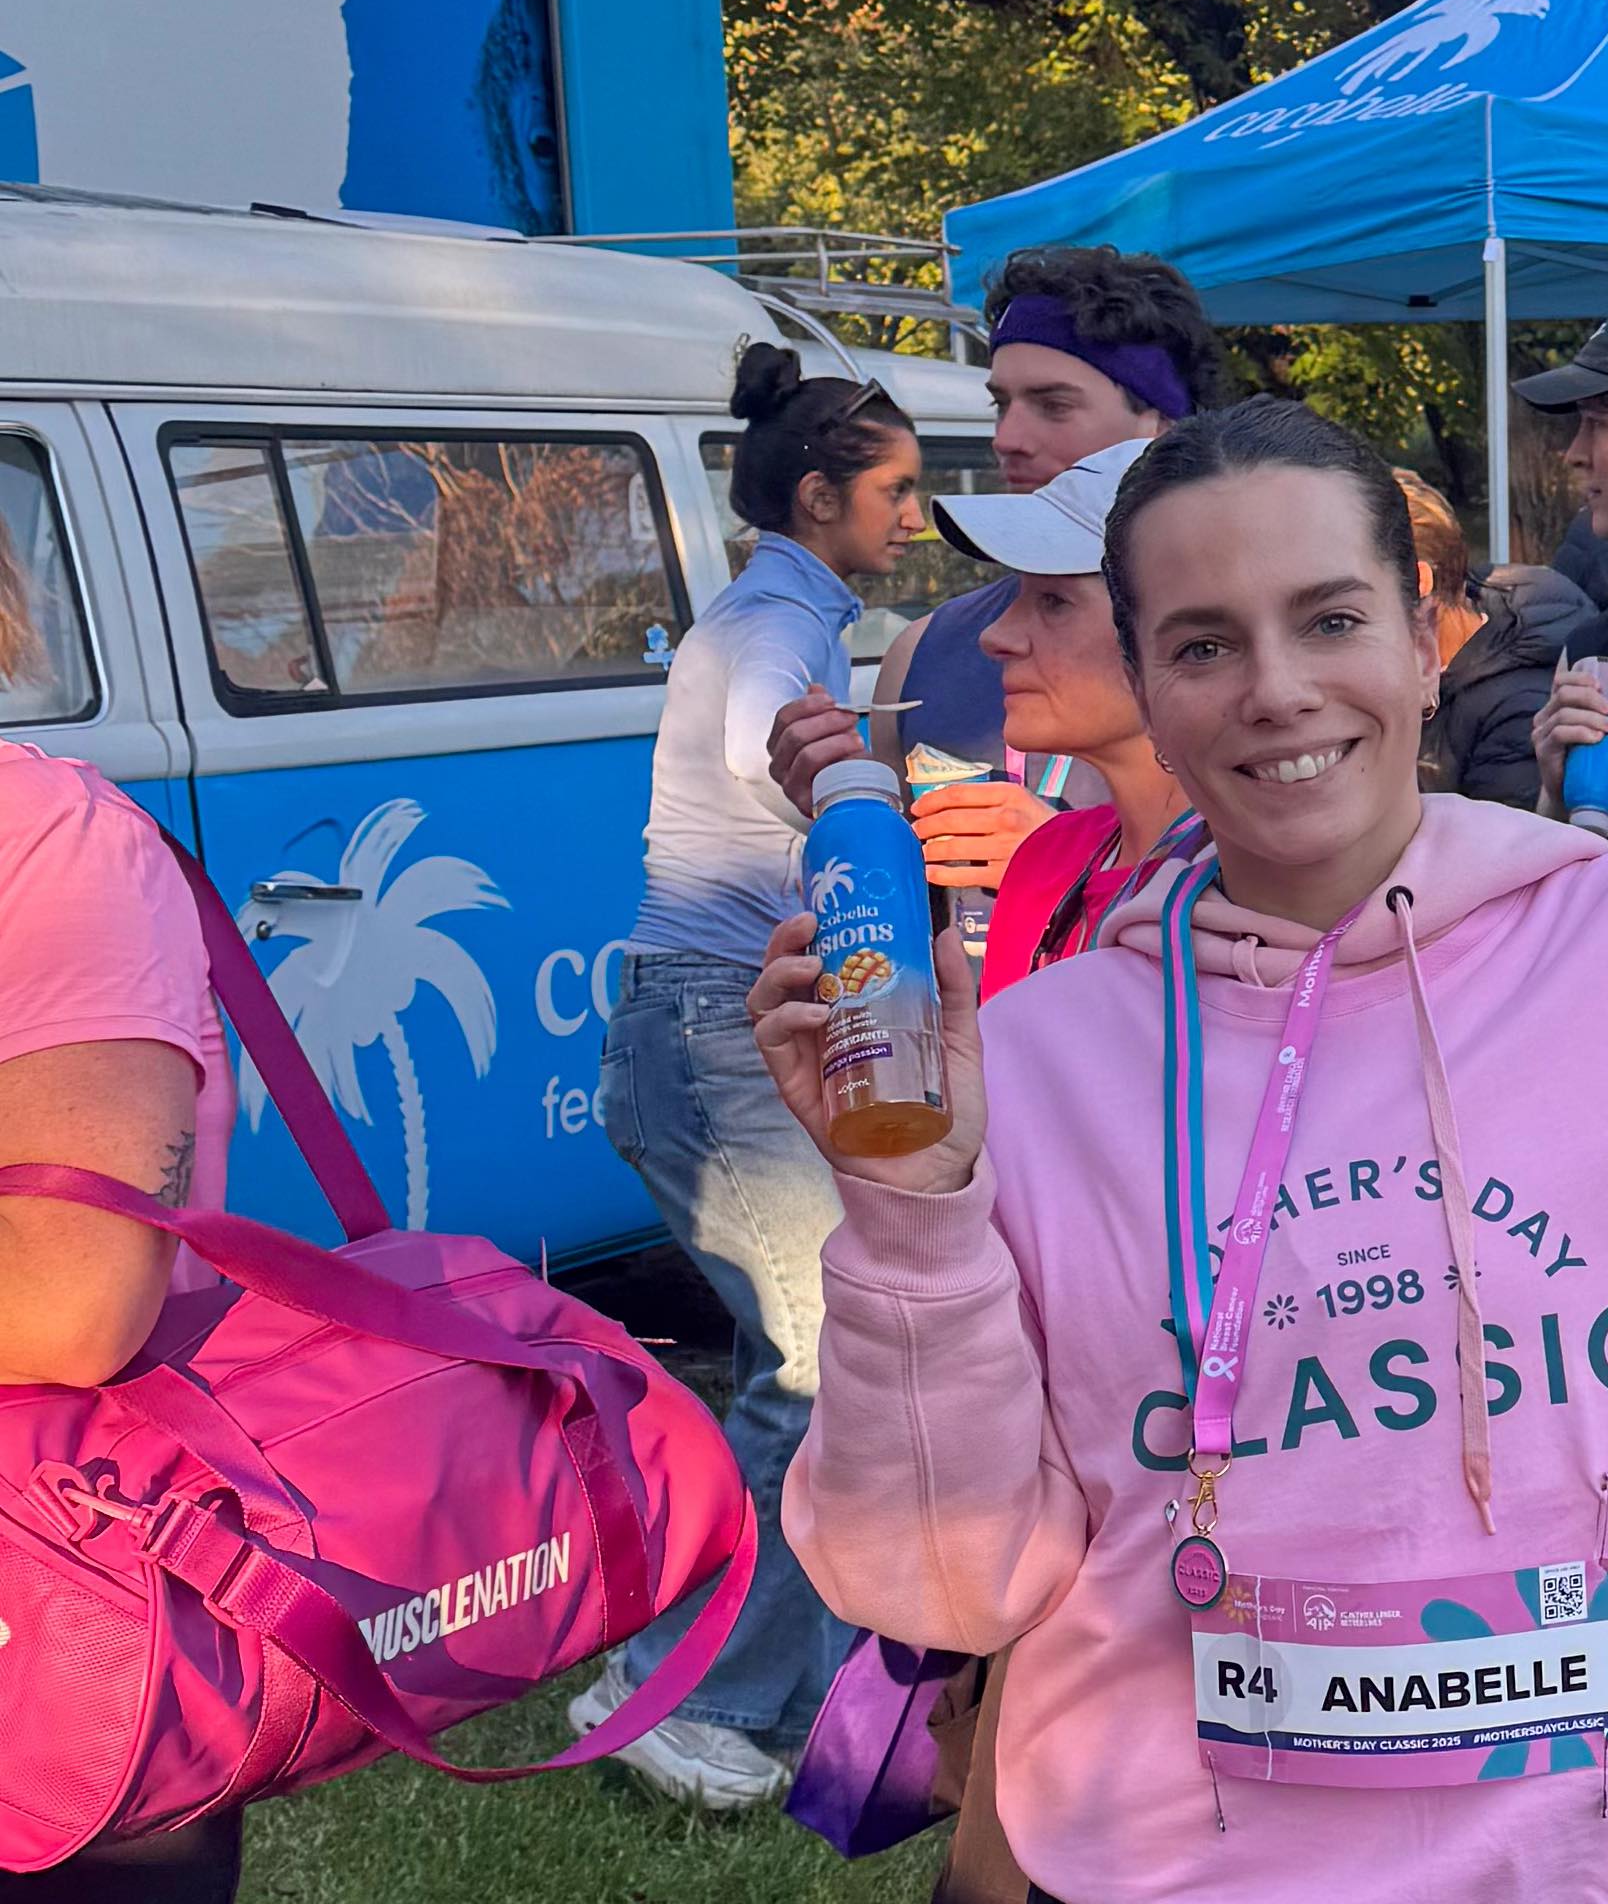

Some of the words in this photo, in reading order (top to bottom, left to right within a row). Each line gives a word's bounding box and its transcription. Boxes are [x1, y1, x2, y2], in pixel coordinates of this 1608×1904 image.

[806, 923, 895, 957] sions
[817, 904, 879, 935] cobella
[1161, 1155, 1444, 1337] HER'S
[1471, 1176, 1588, 1278] DAY
[1337, 1244, 1391, 1267] SINCE
[1316, 1268, 1425, 1319] 1998
[358, 1532, 570, 1665] MUSCLENATION
[1217, 1659, 1278, 1704] R4
[1321, 1654, 1588, 1713] ANABELLE
[1293, 1736, 1351, 1751] MOTHER'S
[1353, 1740, 1377, 1751] DAY
[1379, 1739, 1430, 1751] CLASSIC
[1431, 1735, 1462, 1748] 2025
[1472, 1716, 1606, 1744] #MOTHERSDAYCLASSIC
